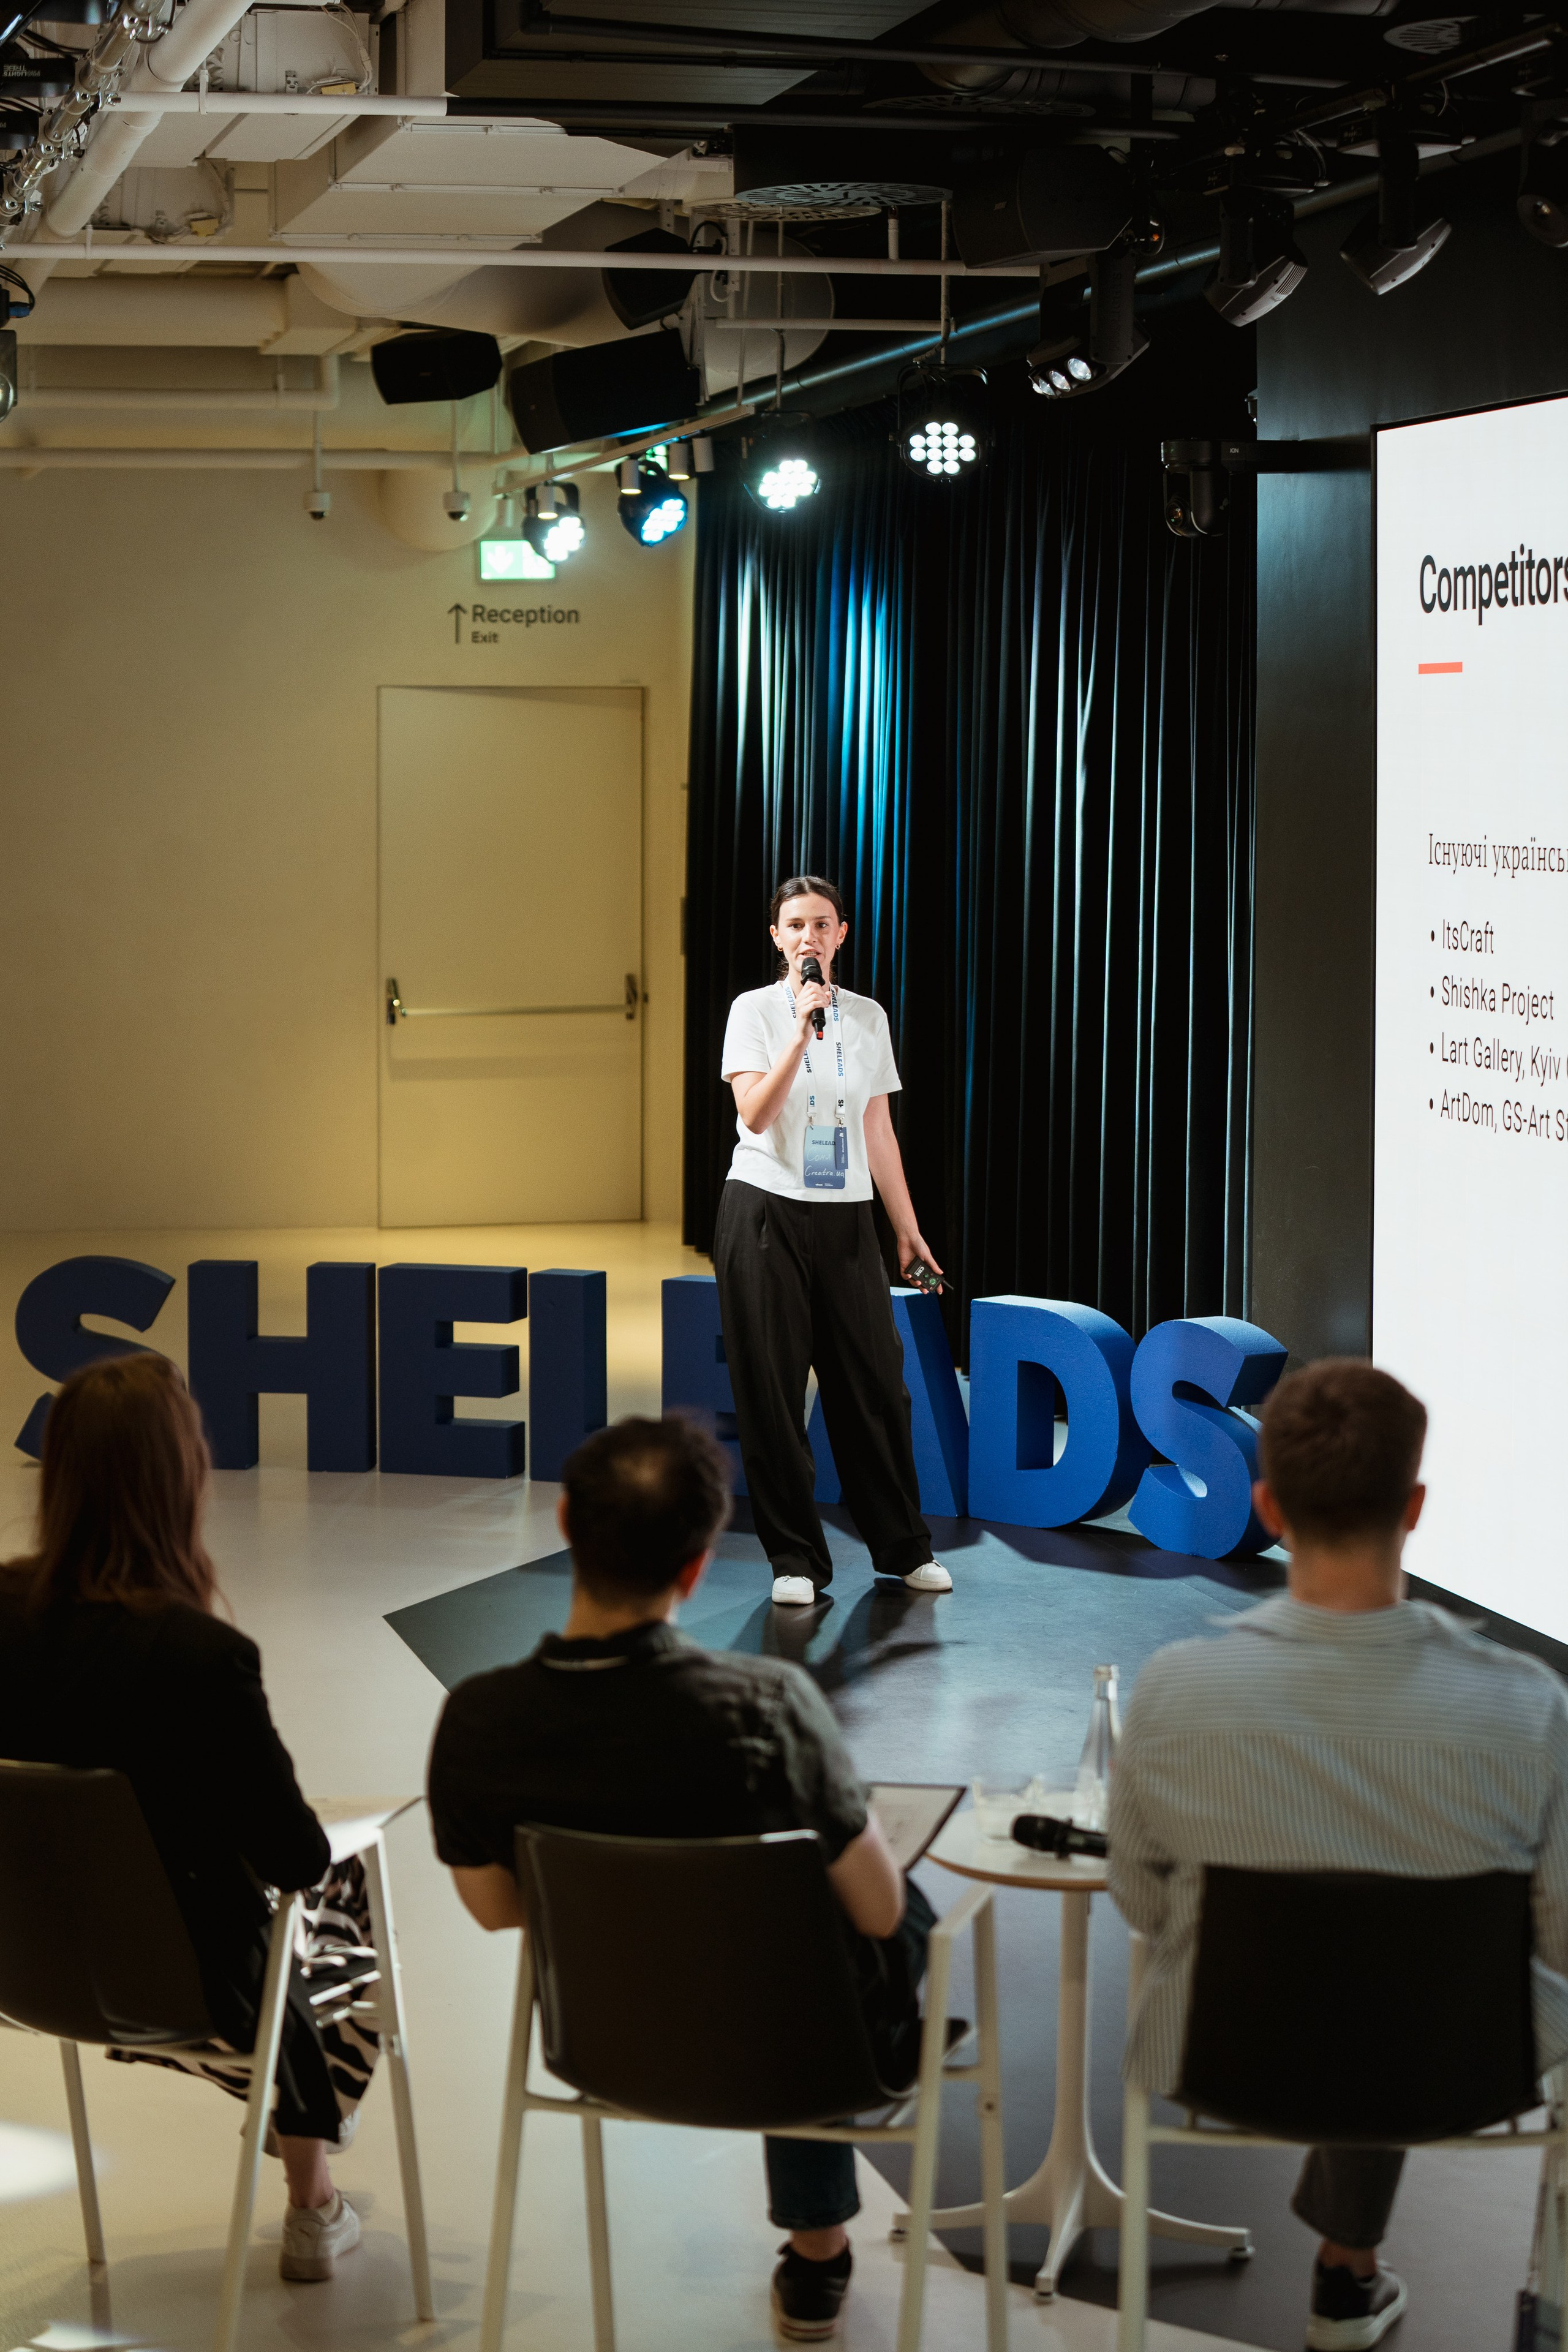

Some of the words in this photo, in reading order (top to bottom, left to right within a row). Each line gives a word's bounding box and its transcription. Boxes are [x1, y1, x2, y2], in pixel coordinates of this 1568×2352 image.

[472, 604, 580, 628] Reception
[471, 631, 499, 644] Exit
[1428, 833, 1487, 875] Існуючі
[1492, 836, 1568, 878] українсь
[1442, 919, 1494, 954] ItsCraft
[831, 989, 839, 1022] SHELEADS
[1441, 975, 1496, 1012] Shishka
[1502, 982, 1554, 1026] Project
[1441, 1031, 1468, 1066] Lart
[1473, 1037, 1525, 1083] Gallery,
[1531, 1045, 1561, 1087] Kyiv
[1441, 1088, 1498, 1134] ArtDom,
[1502, 1099, 1550, 1139] GS-Art
